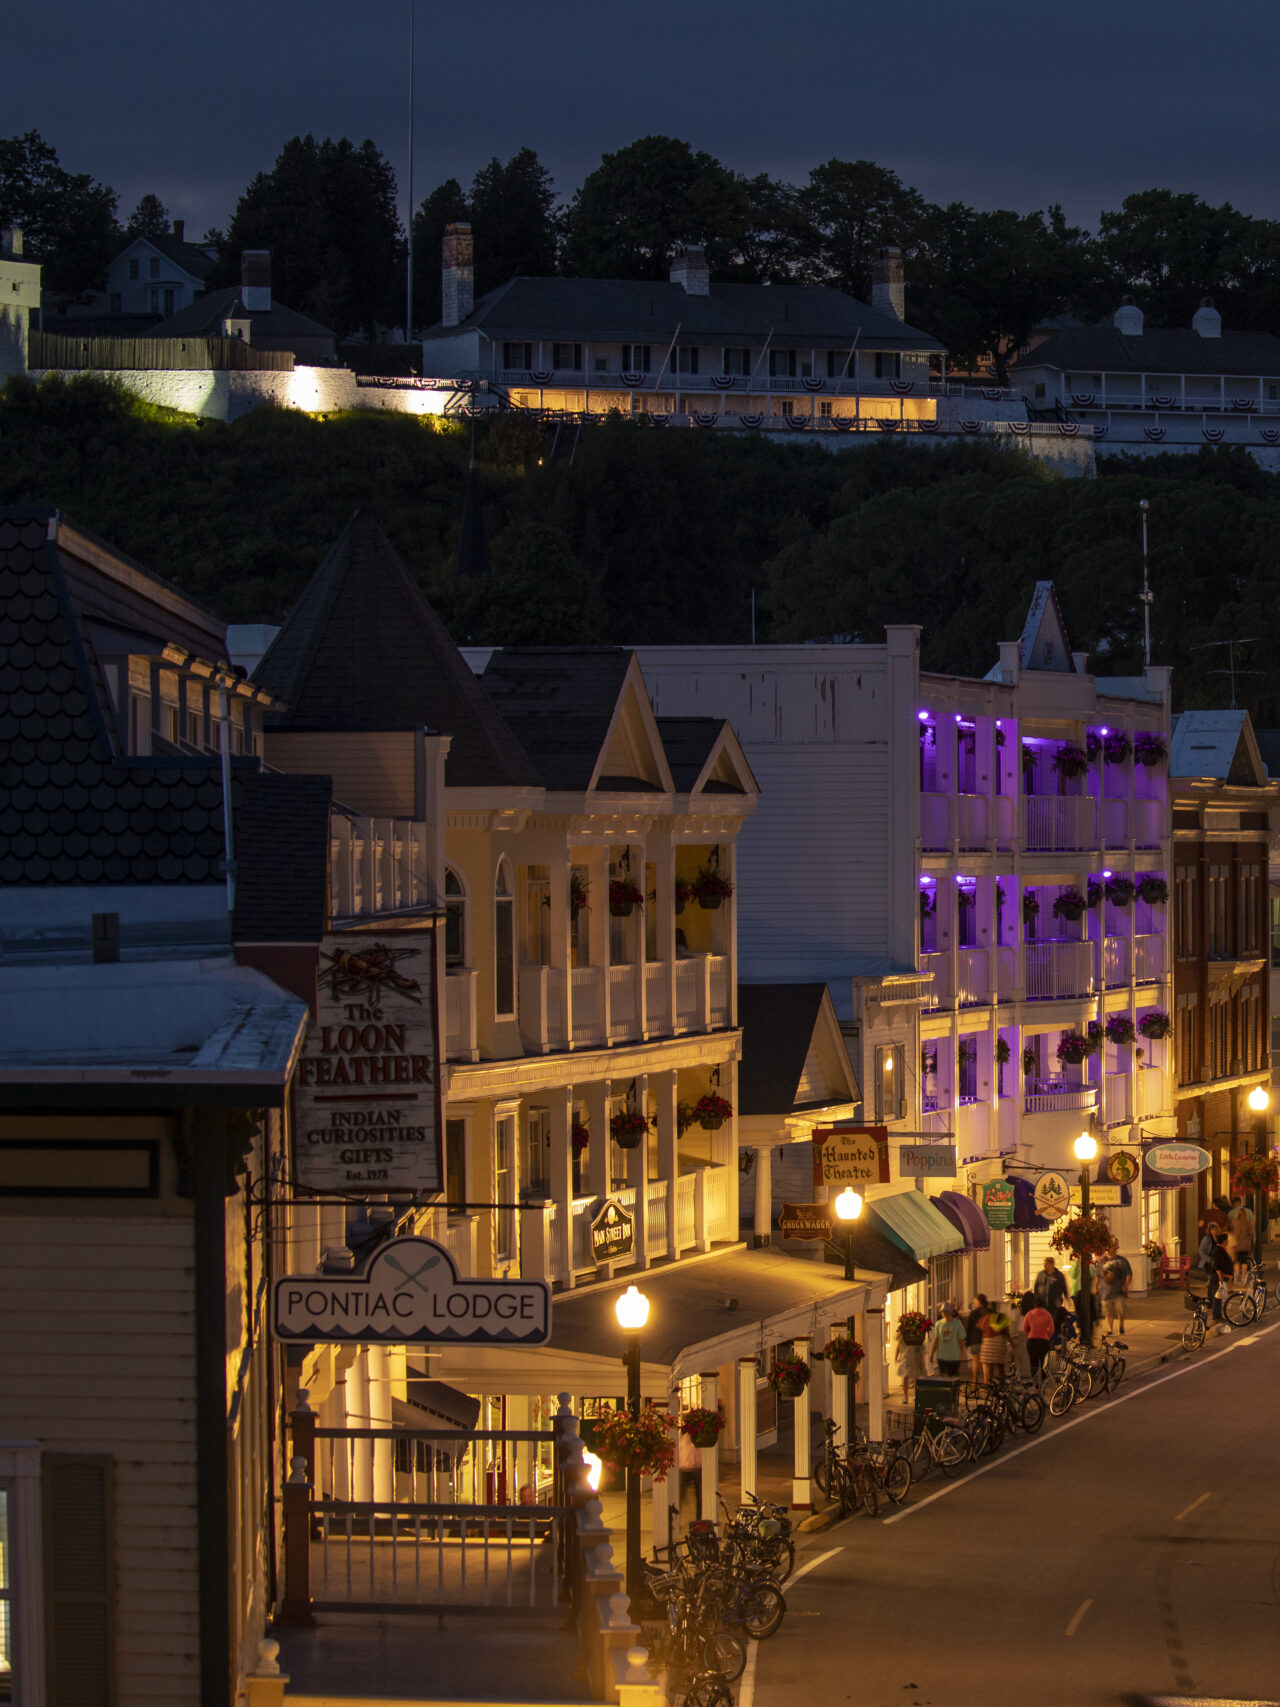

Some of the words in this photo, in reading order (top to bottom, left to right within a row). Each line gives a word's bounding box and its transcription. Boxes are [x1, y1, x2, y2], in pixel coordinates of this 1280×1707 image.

[344, 1003, 384, 1021] The
[320, 1024, 405, 1053] LOON
[298, 1055, 433, 1085] FEATHER
[331, 1110, 400, 1128] INDIAN
[307, 1127, 426, 1144] CURIOSITIES
[841, 1136, 856, 1145] The
[340, 1148, 392, 1164] GIFTS
[823, 1145, 875, 1162] Haunted
[902, 1150, 954, 1171] Poppins
[346, 1170, 365, 1180] Est.
[824, 1165, 874, 1180] Theatre
[782, 1219, 830, 1229] CHUCKWAGON
[288, 1290, 414, 1318] PONTIAC
[432, 1293, 534, 1319] LODGE
